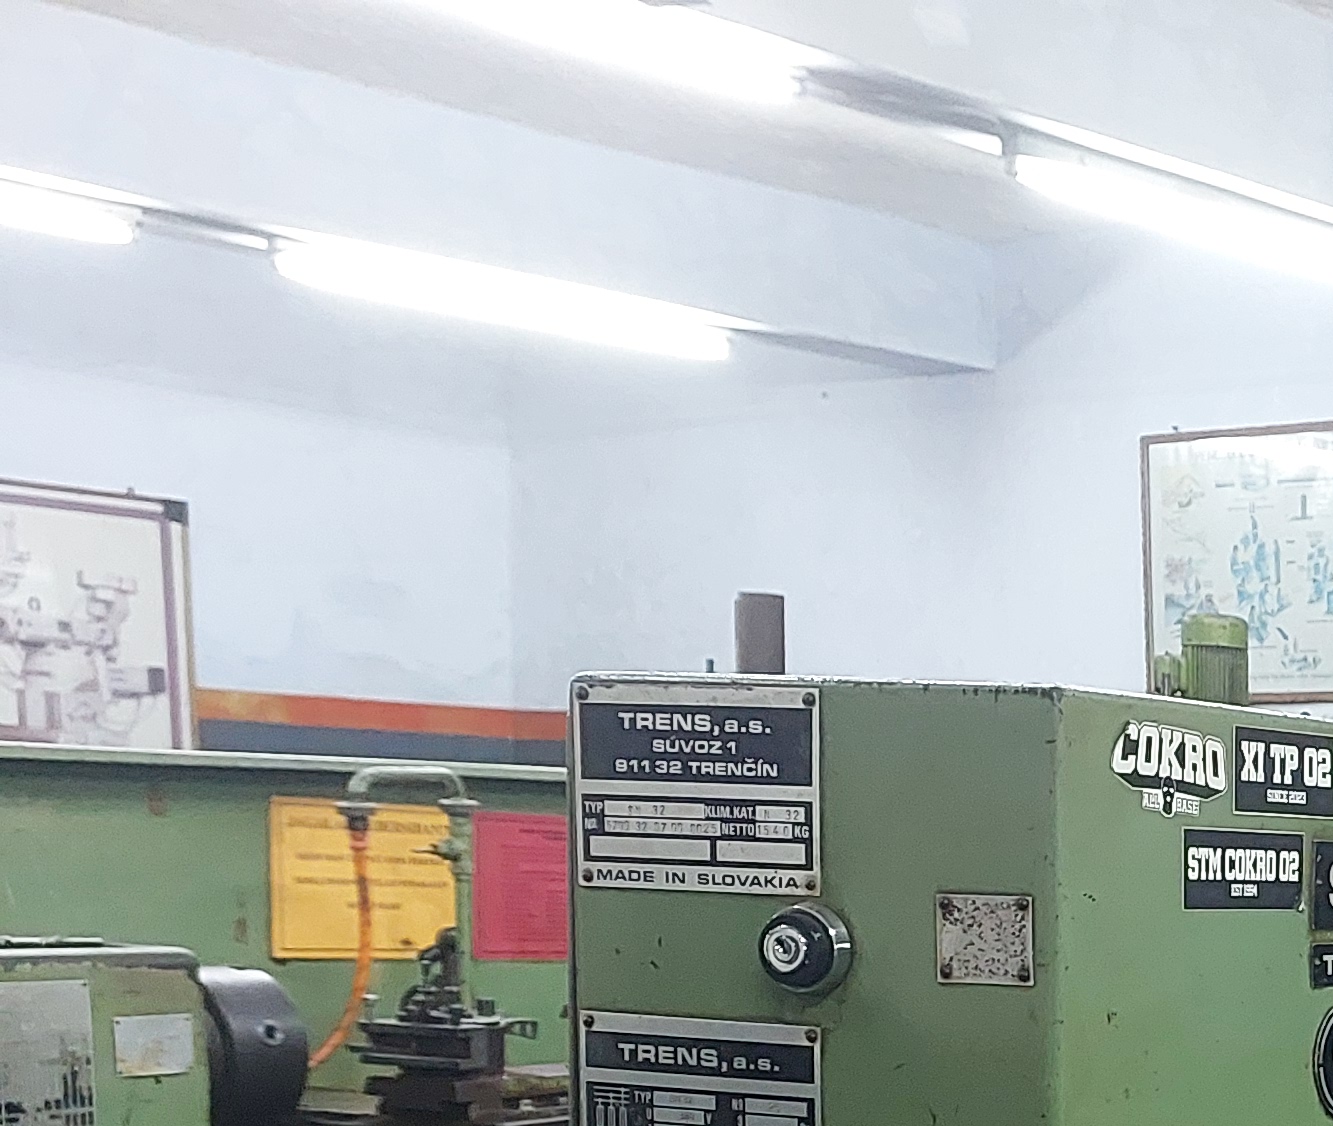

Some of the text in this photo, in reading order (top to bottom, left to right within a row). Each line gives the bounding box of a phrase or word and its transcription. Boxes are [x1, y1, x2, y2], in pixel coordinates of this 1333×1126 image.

[617, 711, 772, 737] TRENS, a.s.
[651, 734, 737, 755] SÚVOZ 1
[614, 757, 779, 778] 911 32 TRENČÍN
[1112, 722, 1227, 791] COKRO
[1240, 740, 1333, 789] XI TP 02
[583, 801, 603, 815] TYP
[652, 805, 666, 816] 32
[785, 810, 800, 820] 32
[1142, 792, 1200, 815] ALL BASE
[720, 822, 755, 837] NETTO
[794, 825, 810, 838] KG
[1187, 846, 1300, 882] STM COKRO 02
[596, 868, 799, 890] MADE IN SLOVAKIA
[617, 1042, 781, 1073] TRENS, a.s.
[634, 1090, 651, 1104] TYP
